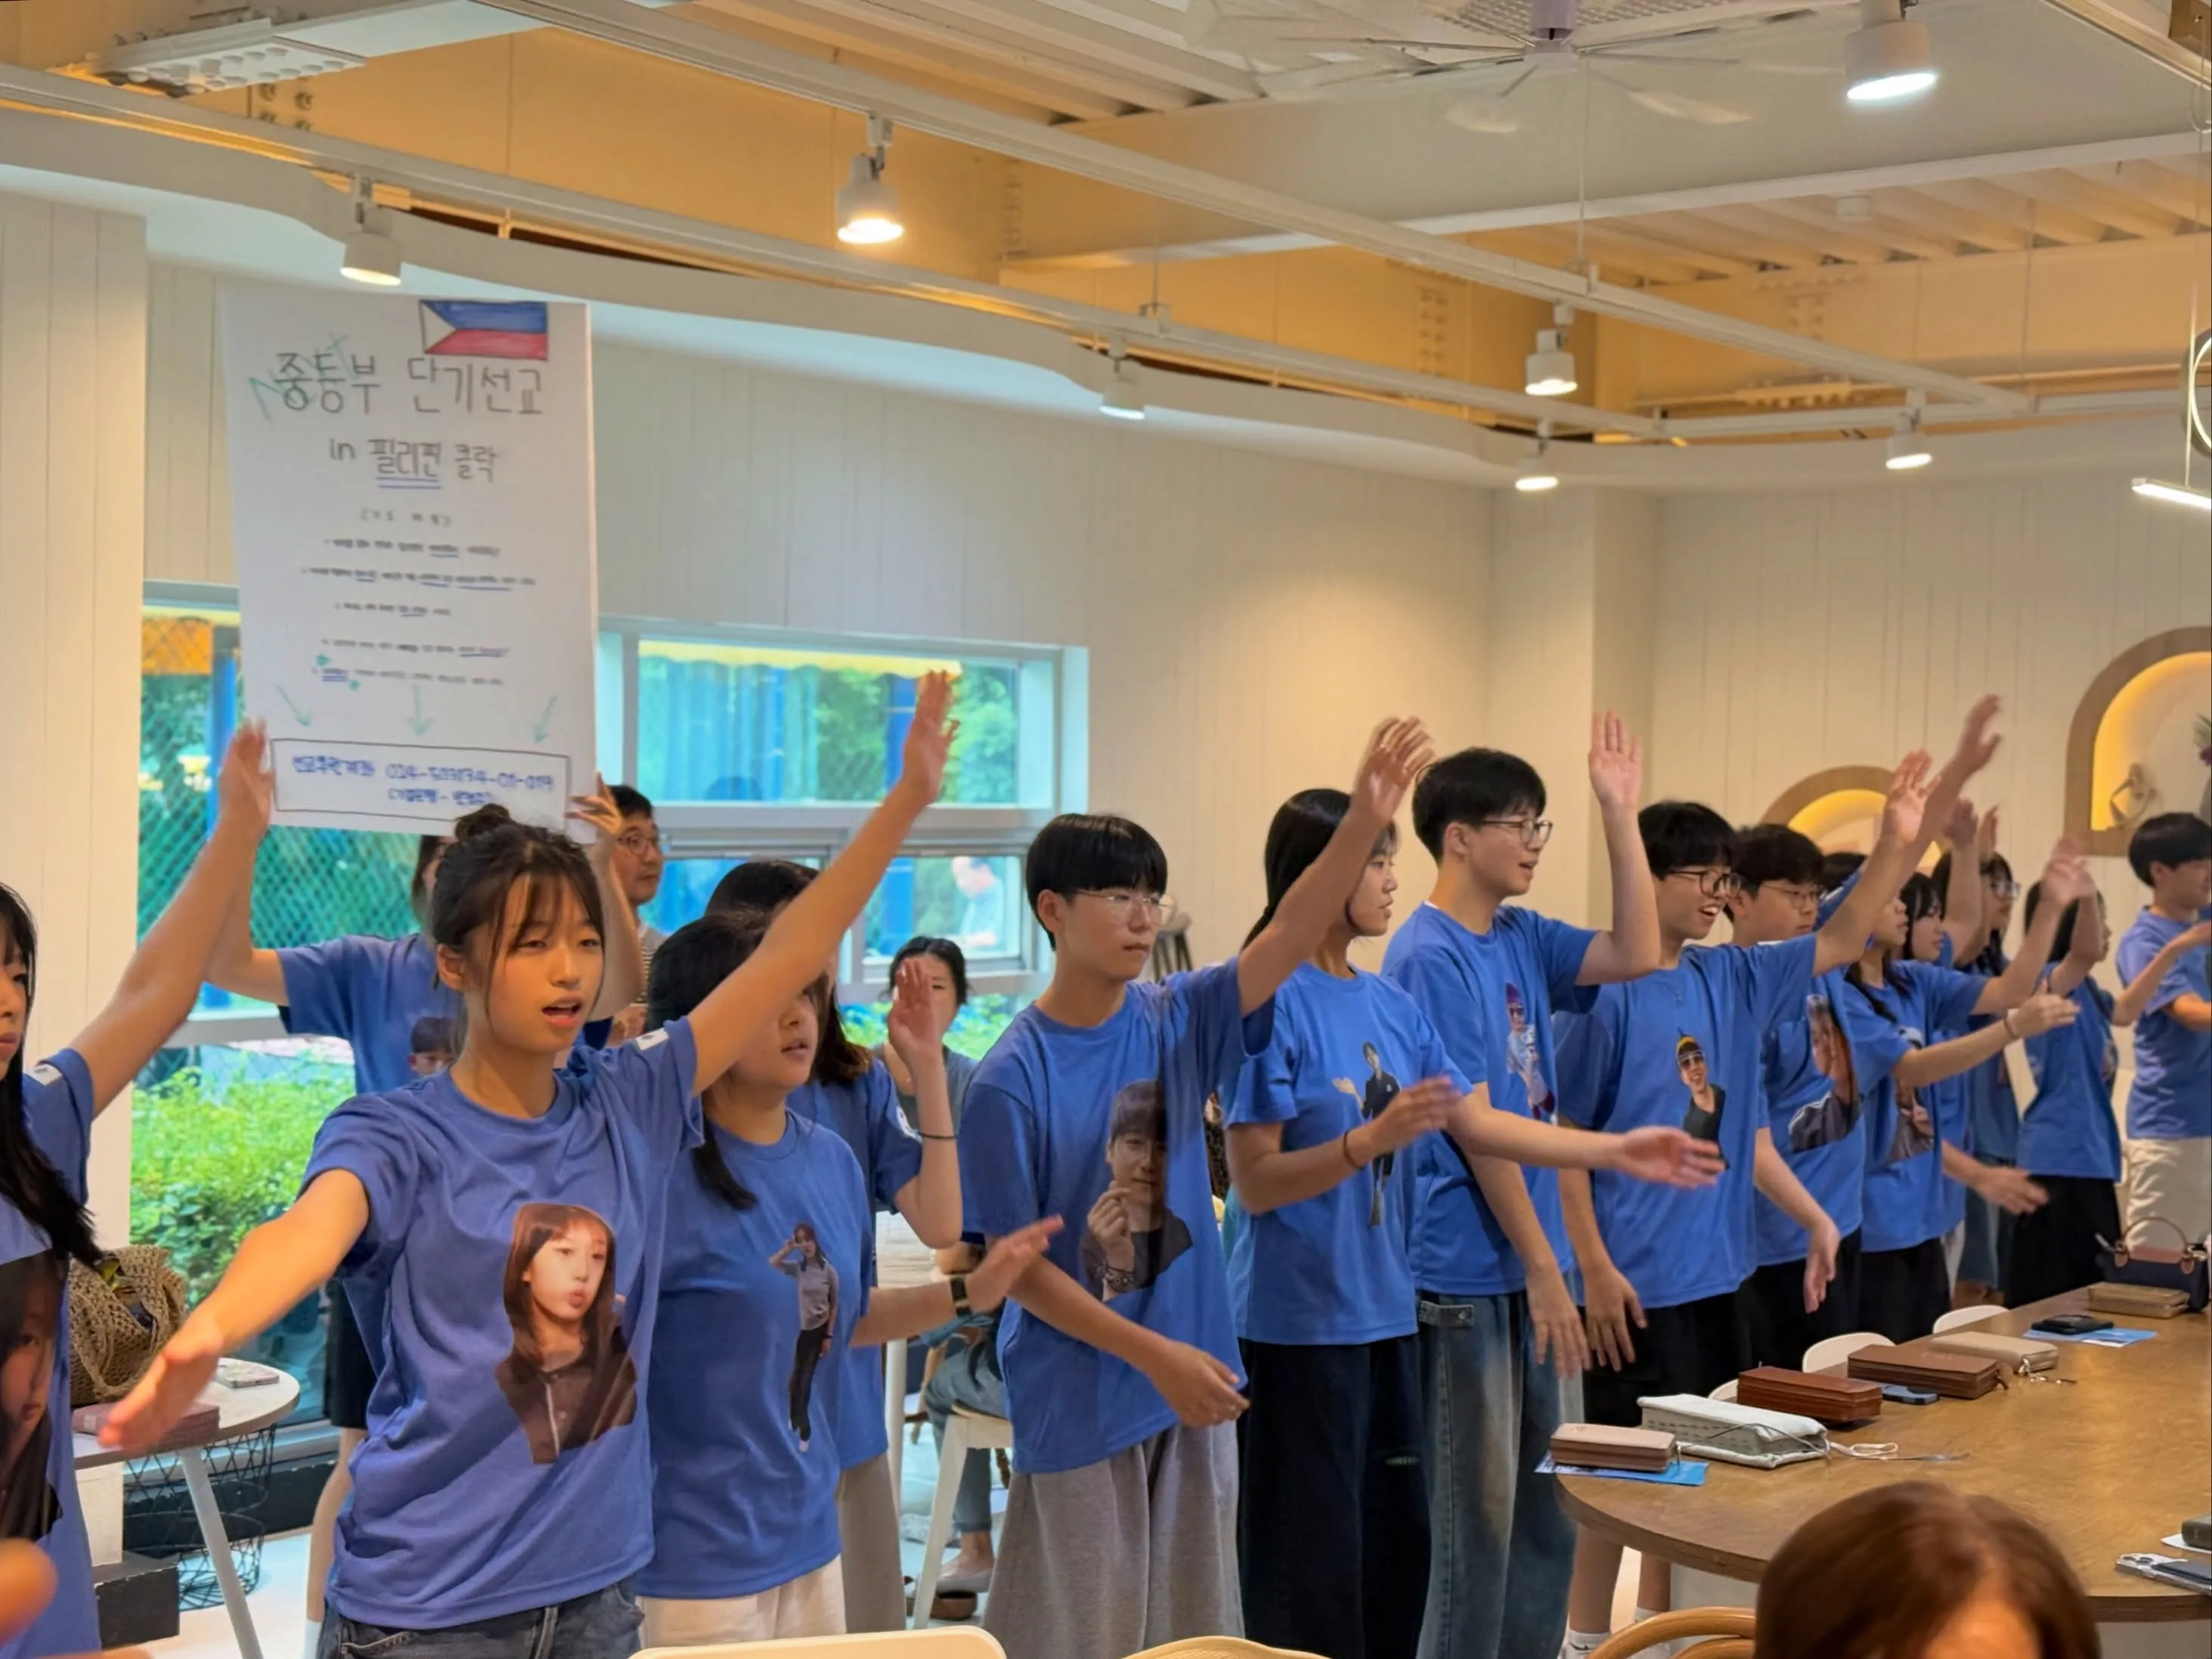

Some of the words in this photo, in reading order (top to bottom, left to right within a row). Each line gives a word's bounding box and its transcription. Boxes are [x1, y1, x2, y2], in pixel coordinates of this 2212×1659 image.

[274, 352, 380, 415] 중등부
[407, 357, 544, 414] 단기선교
[330, 438, 356, 460] in
[367, 438, 442, 478] 필리핀
